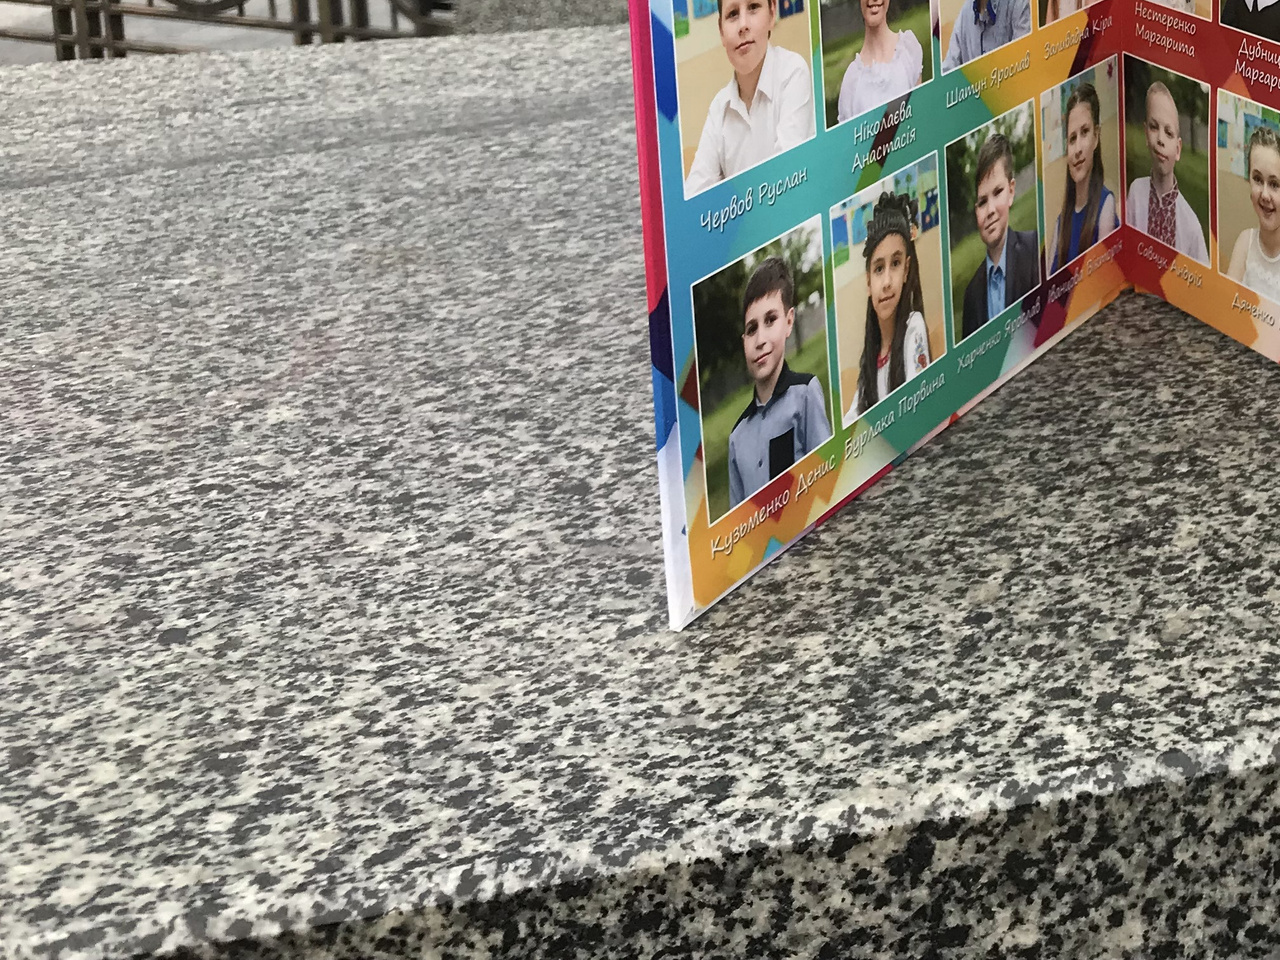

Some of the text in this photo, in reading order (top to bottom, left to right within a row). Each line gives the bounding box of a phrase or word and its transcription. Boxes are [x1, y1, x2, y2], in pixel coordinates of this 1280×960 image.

[1092, 14, 1113, 36] Кіра
[1135, 1, 1197, 36] Нестеренко
[1135, 23, 1196, 58] Маргарита
[946, 49, 1031, 109] Шатун Ярослав
[853, 100, 913, 146] Ніколаєва
[851, 125, 917, 174] Анастасія
[700, 167, 808, 233] Червов Руслан
[1231, 292, 1275, 326] Дяченко
[844, 409, 895, 461] Бурлака
[710, 454, 836, 559] Кузьменко Денис
